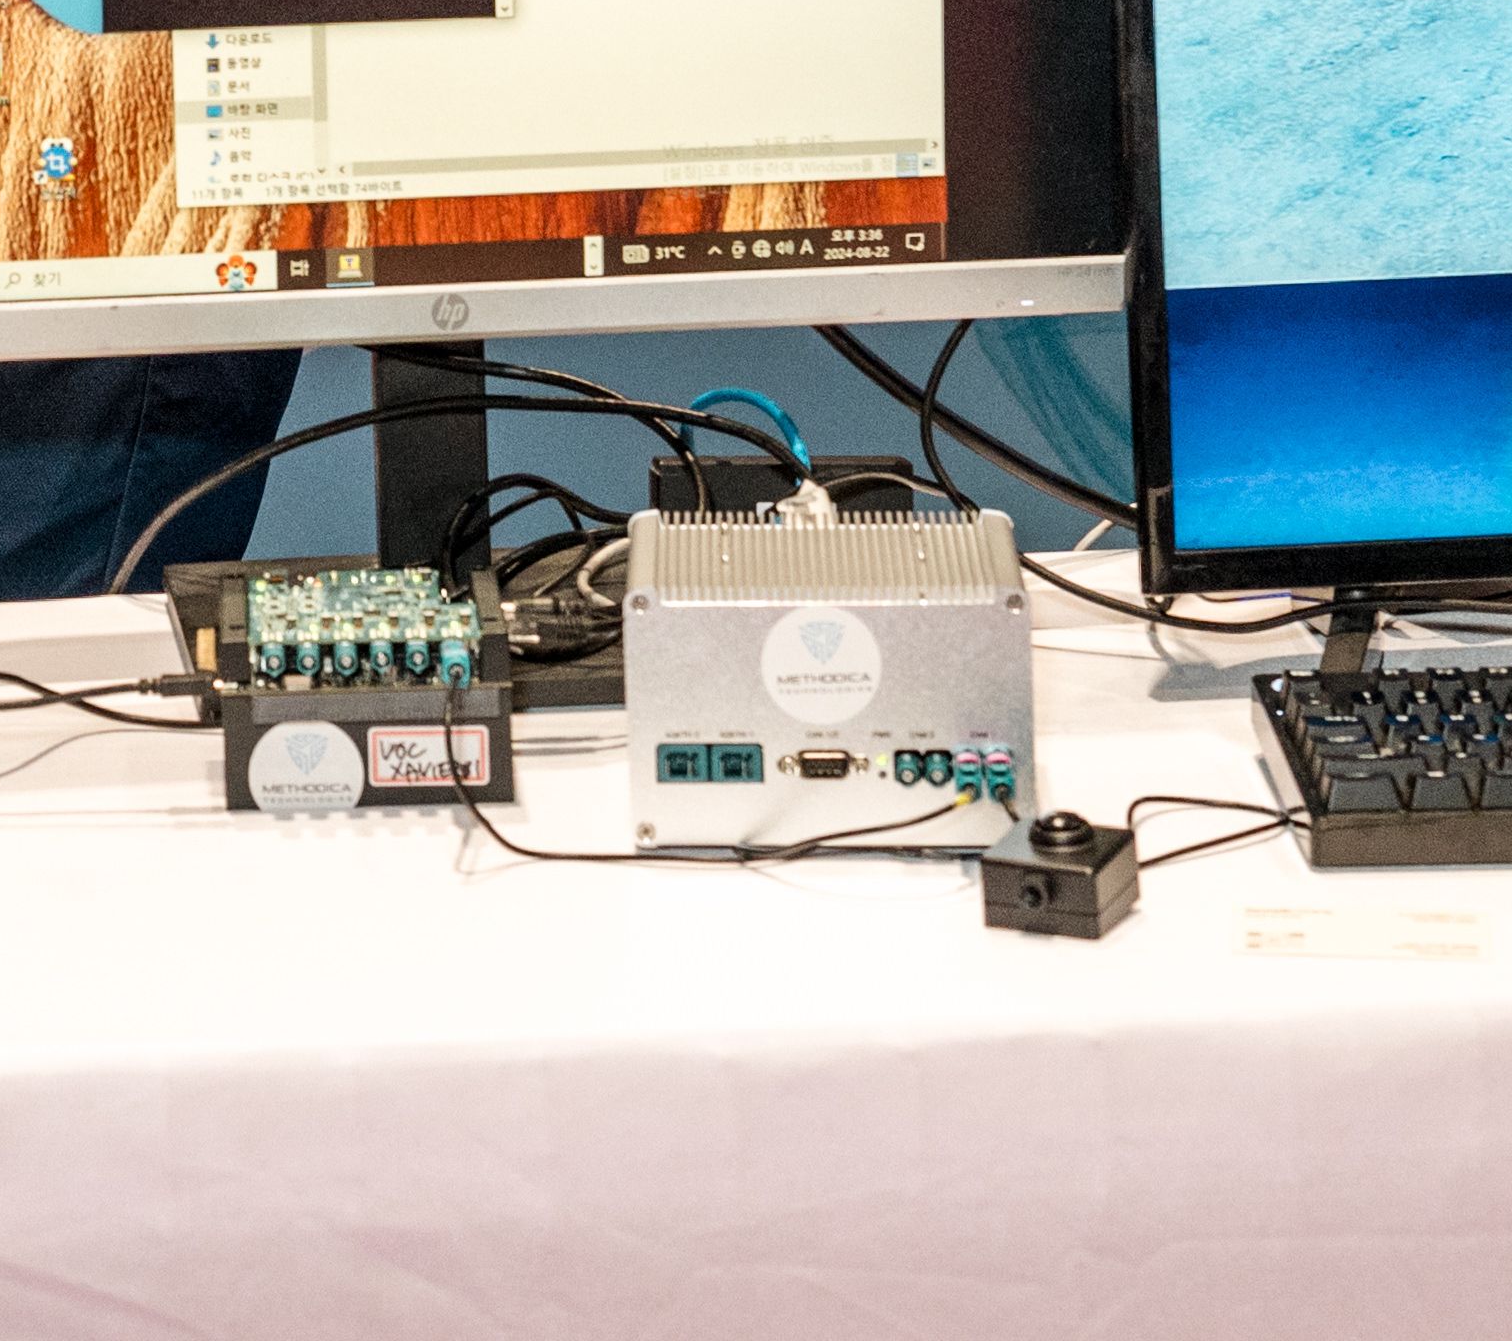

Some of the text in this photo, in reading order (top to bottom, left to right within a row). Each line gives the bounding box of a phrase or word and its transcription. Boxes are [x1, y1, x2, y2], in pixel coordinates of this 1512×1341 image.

[857, 228, 883, 241] 3:36
[823, 245, 890, 260] 2024-08-22
[433, 293, 468, 330] hp
[776, 673, 872, 685] METHODICA
[261, 783, 352, 793] METHODICA
